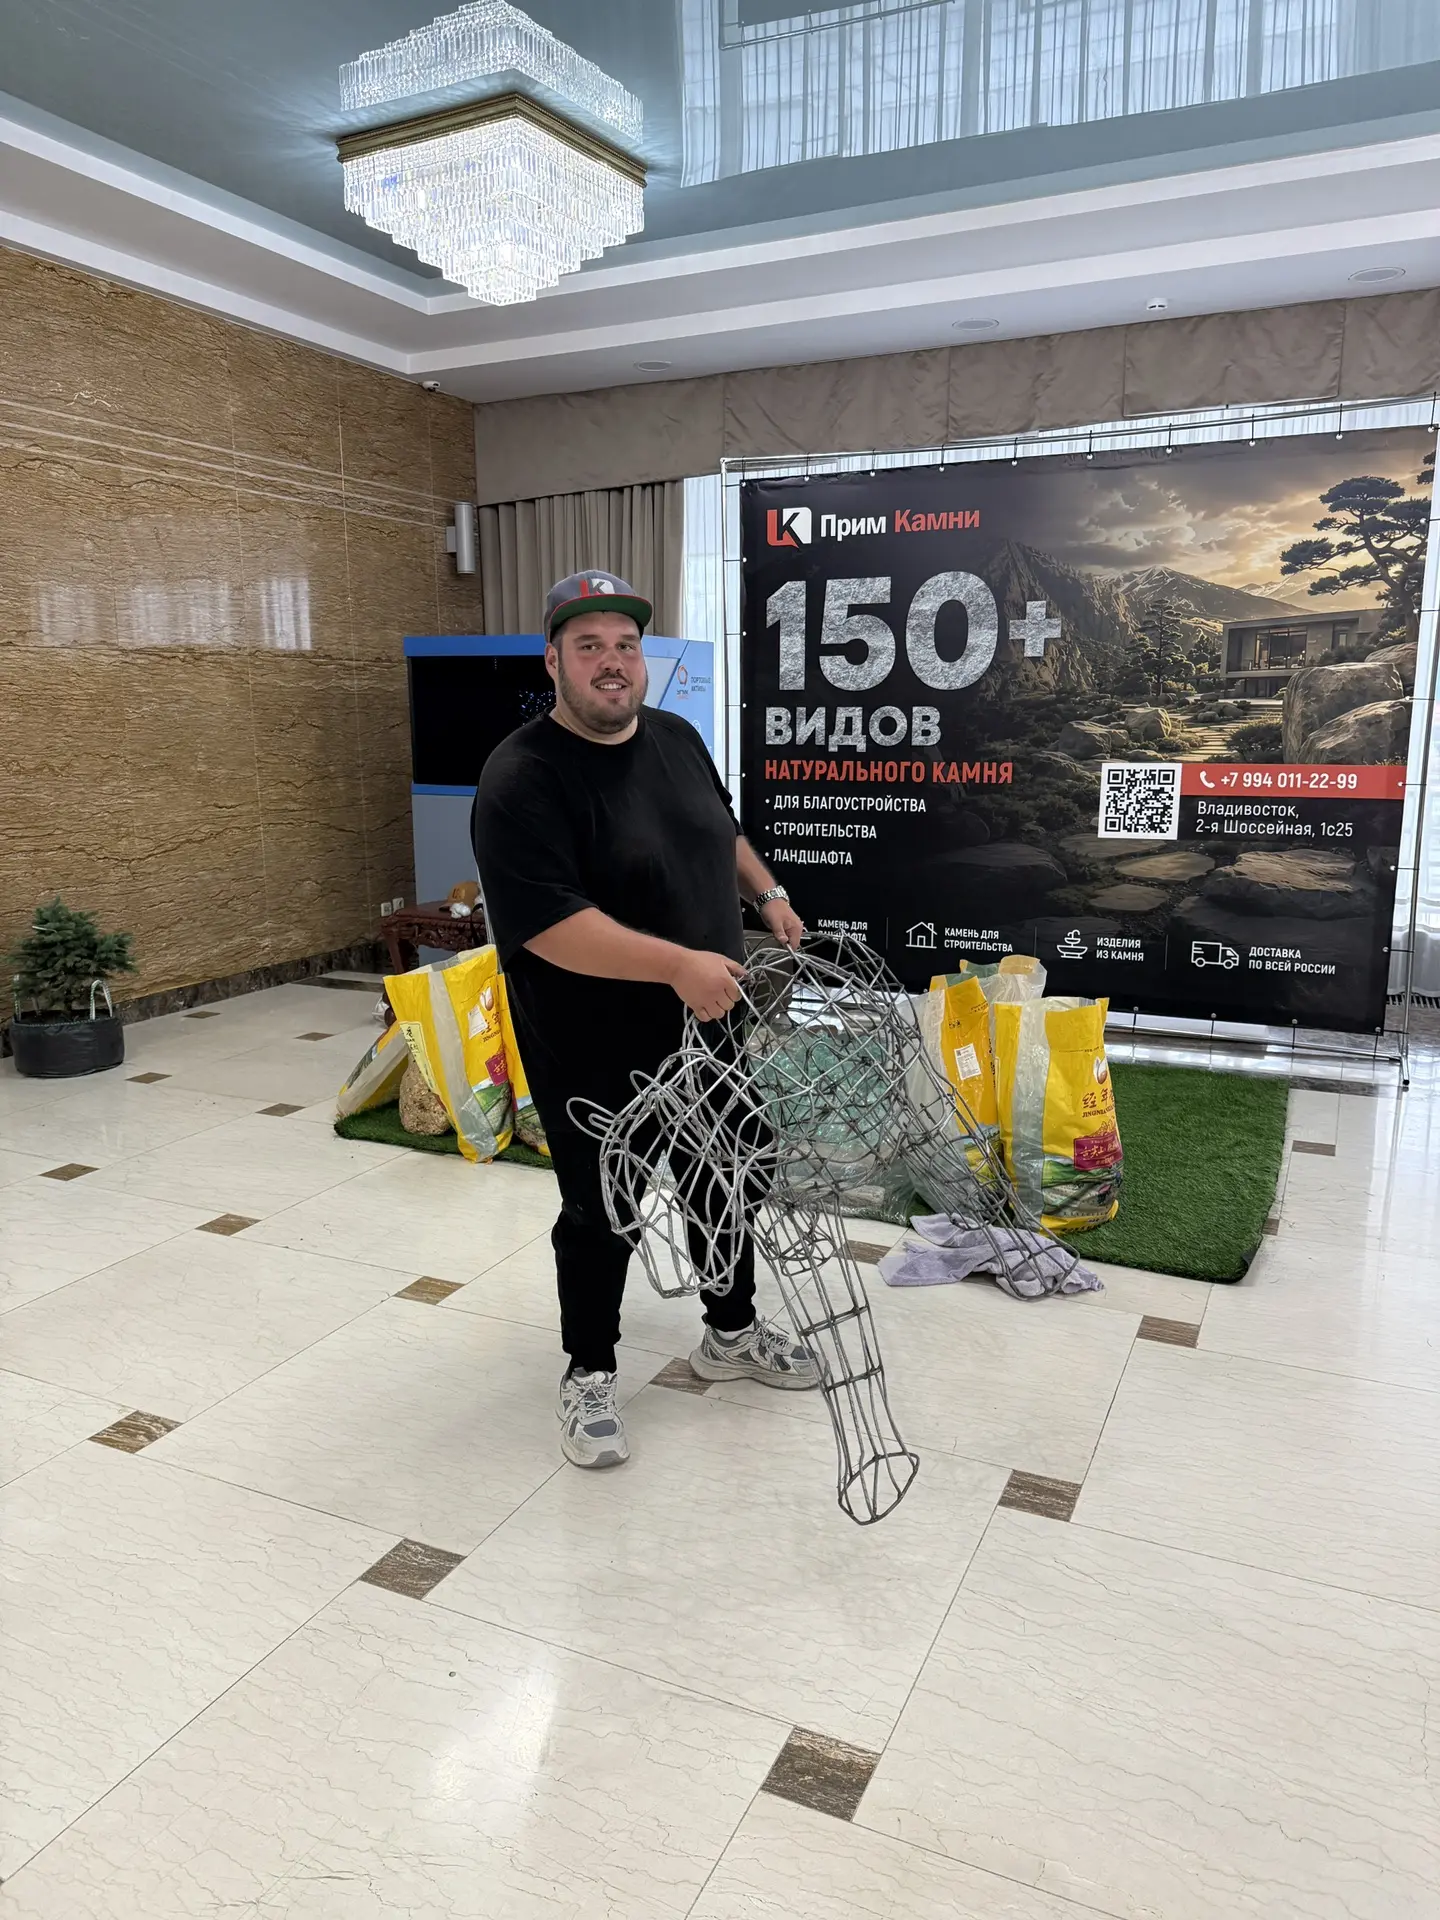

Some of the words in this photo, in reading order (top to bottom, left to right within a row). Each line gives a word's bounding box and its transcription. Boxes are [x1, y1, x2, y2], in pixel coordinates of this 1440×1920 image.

[821, 514, 886, 541] Прим
[894, 509, 980, 533] Камни
[766, 571, 1062, 691] 150+
[766, 706, 941, 752] ВИДОВ
[765, 759, 926, 783] НАТУРАЛЬНОГО
[932, 761, 1013, 784] КАМНЯ
[1221, 772, 1238, 788] +7
[1243, 772, 1273, 788] 994
[1277, 772, 1358, 790] 011-22-99
[773, 795, 800, 810] ДЛЯ
[803, 795, 927, 813] БЛАГОУСТРОЙСТВА
[1197, 801, 1300, 818] Владивосток,
[773, 822, 877, 839] СТРОИТЕЛЬСТВА
[1195, 819, 1219, 834] 2-я
[1223, 820, 1316, 837] Шоссейная,
[773, 849, 853, 866] ЛАНДШАФТА
[817, 919, 849, 929] КАМЕНЬ
[850, 921, 868, 931] ДЛЯ
[944, 928, 980, 939] КАМЕНЬ
[980, 929, 999, 940] ДЛЯ
[944, 939, 1013, 952] СТРОИТЕЛЬСТВА
[1096, 937, 1141, 949] ИЗДЕЛИЯ
[1096, 950, 1109, 959] ИЗ
[1111, 951, 1144, 962] КАМНЯ
[1248, 946, 1302, 959] ДОСТАВКА
[1248, 960, 1263, 970] ПО
[1265, 960, 1292, 971] ВСЕЙ
[1295, 962, 1336, 975] РОССИИ
